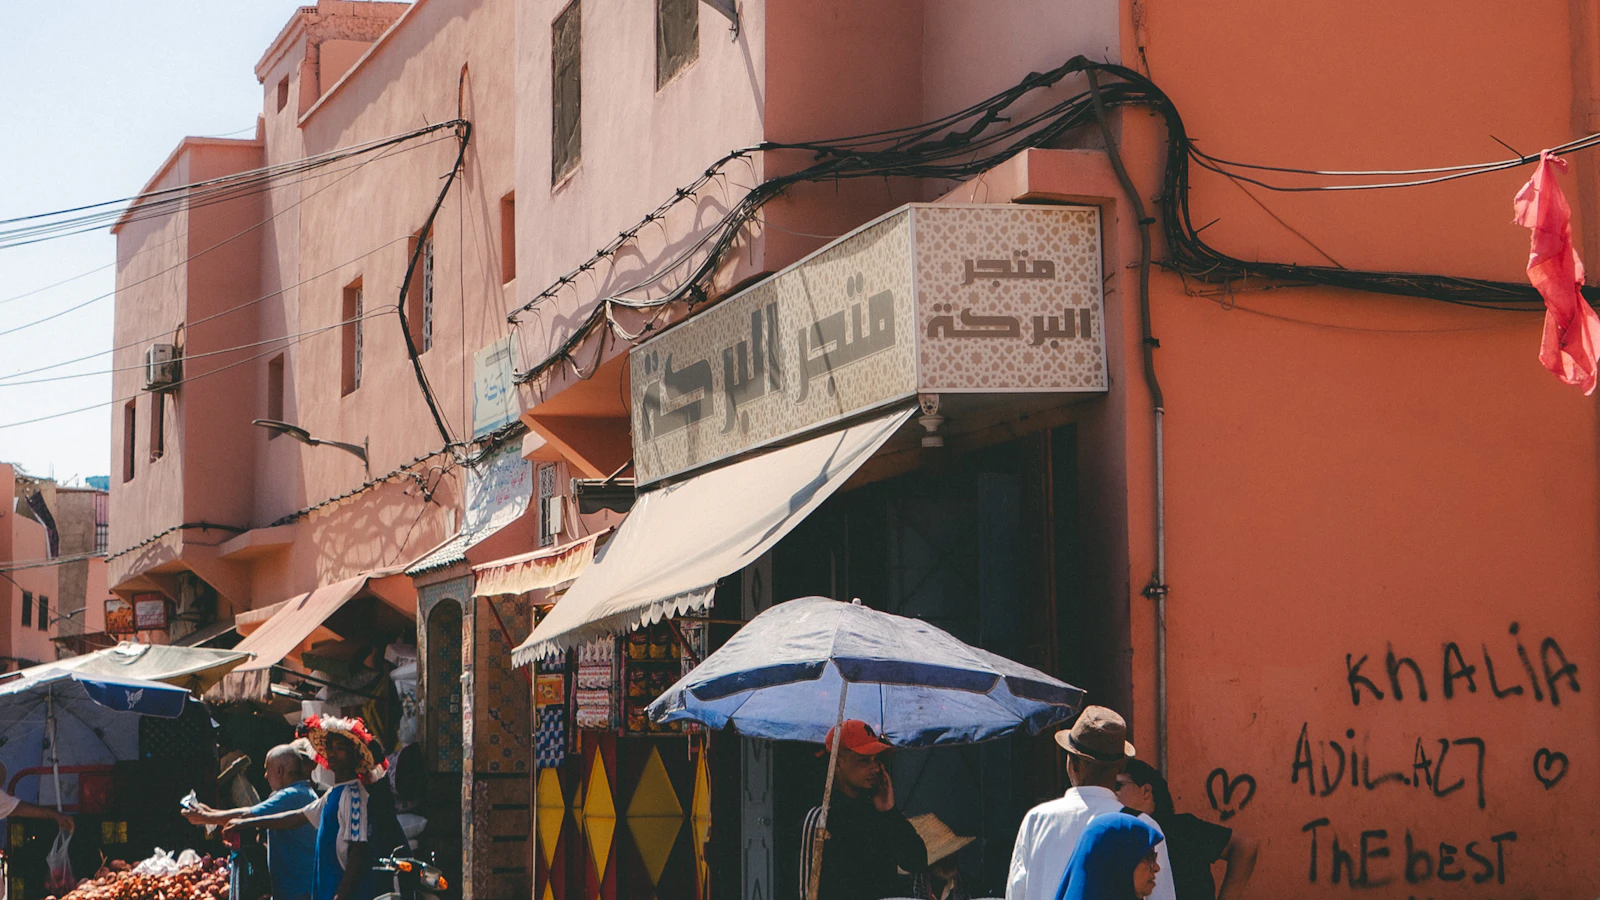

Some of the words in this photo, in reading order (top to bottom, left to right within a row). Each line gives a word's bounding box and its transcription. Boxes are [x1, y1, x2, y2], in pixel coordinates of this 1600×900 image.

[960, 249, 1056, 288] متجر
[795, 271, 896, 405] متجر
[927, 303, 1092, 349] البركة
[641, 301, 781, 443] البركة
